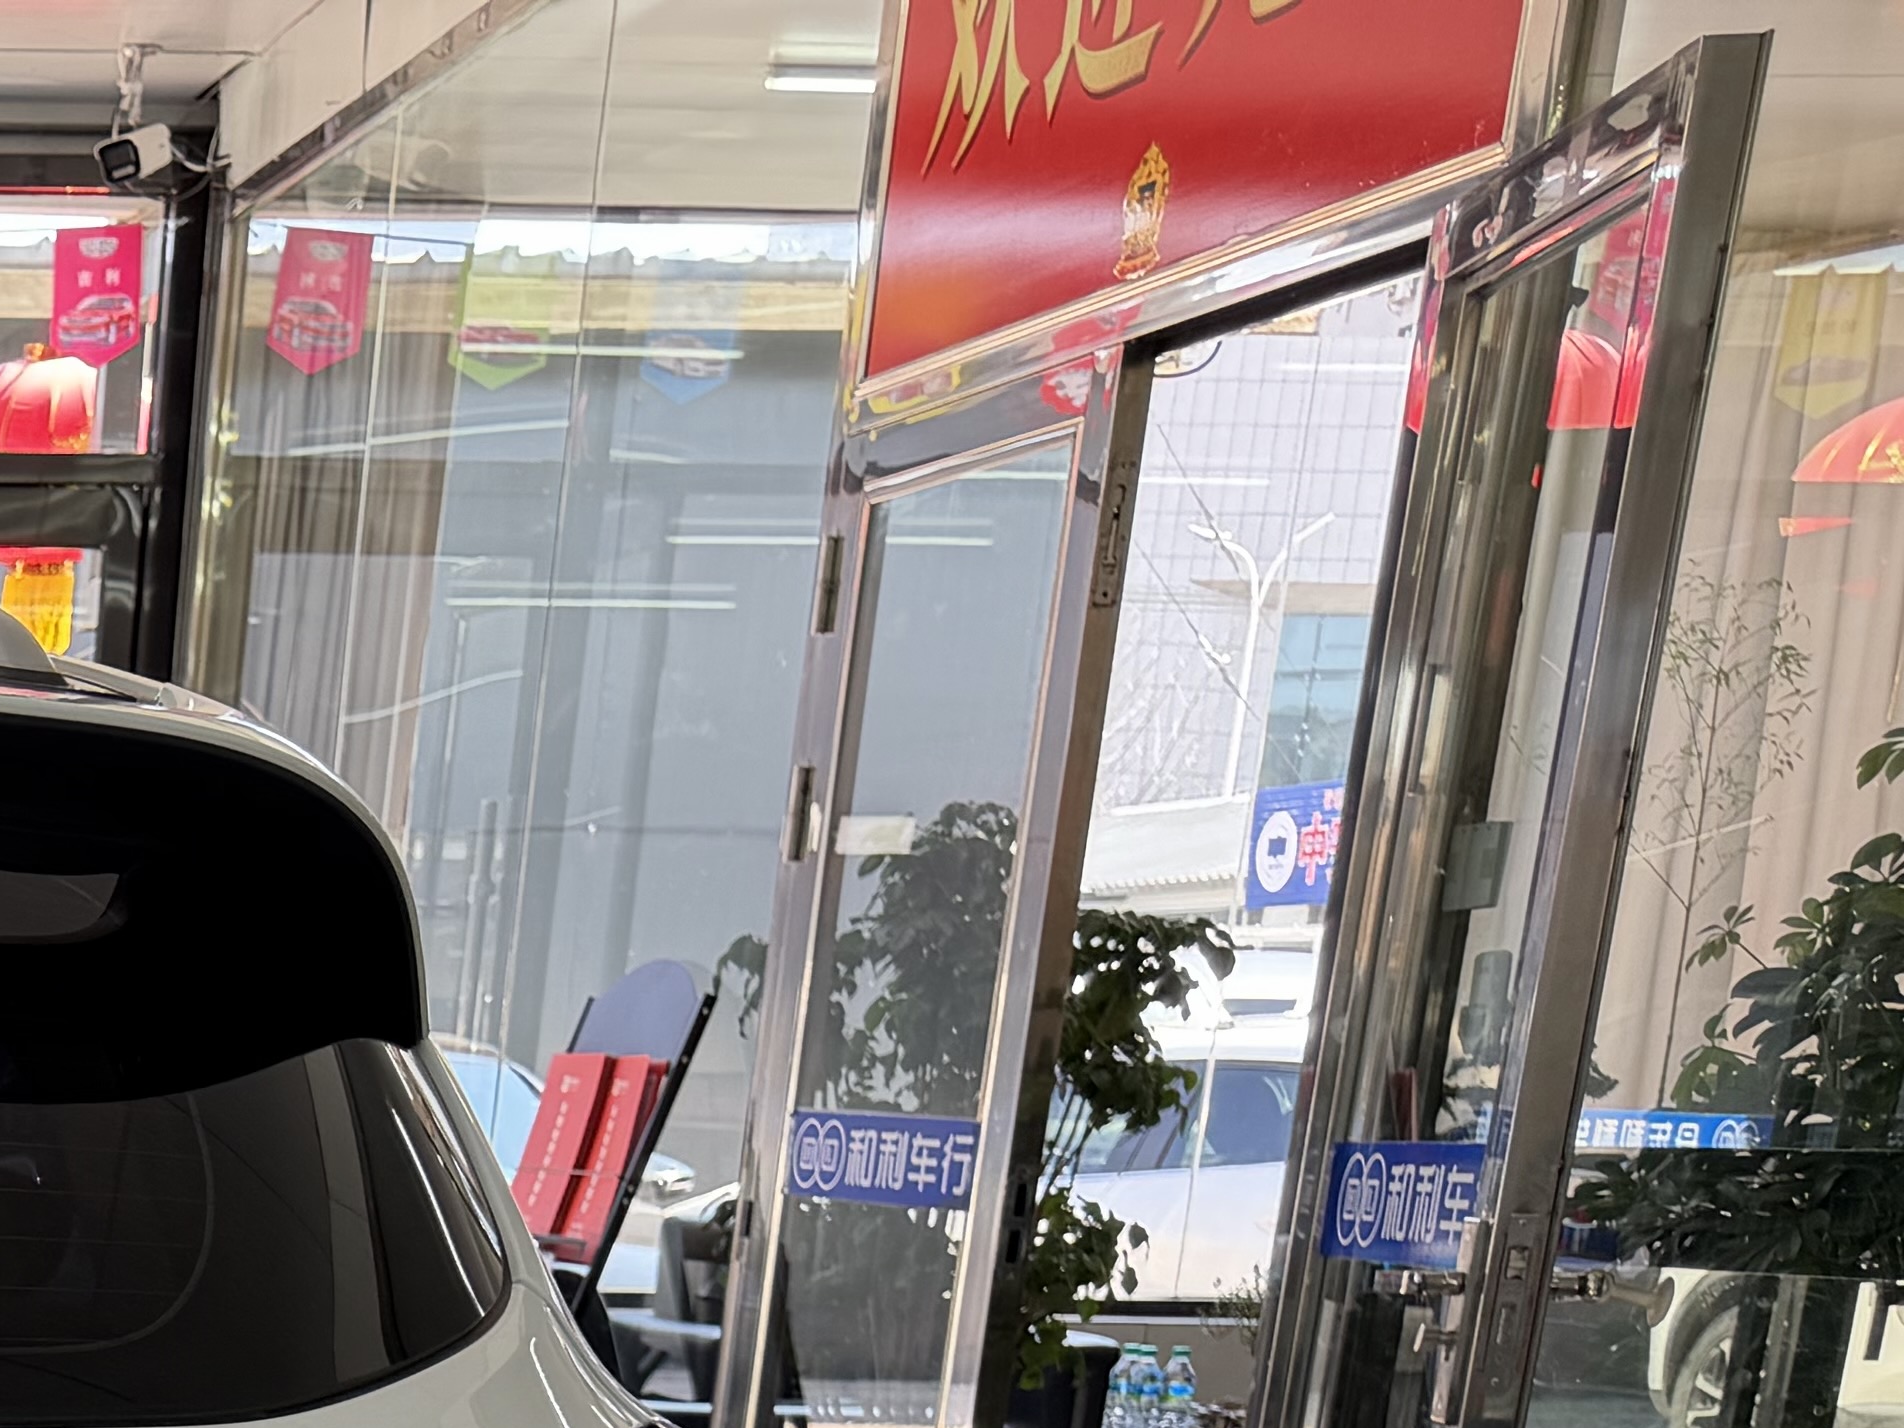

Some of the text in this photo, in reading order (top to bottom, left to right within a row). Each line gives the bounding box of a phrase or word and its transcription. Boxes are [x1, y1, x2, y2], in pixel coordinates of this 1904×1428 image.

[844, 1128, 975, 1196] 和利车行
[1380, 1163, 1480, 1247] 和利车
